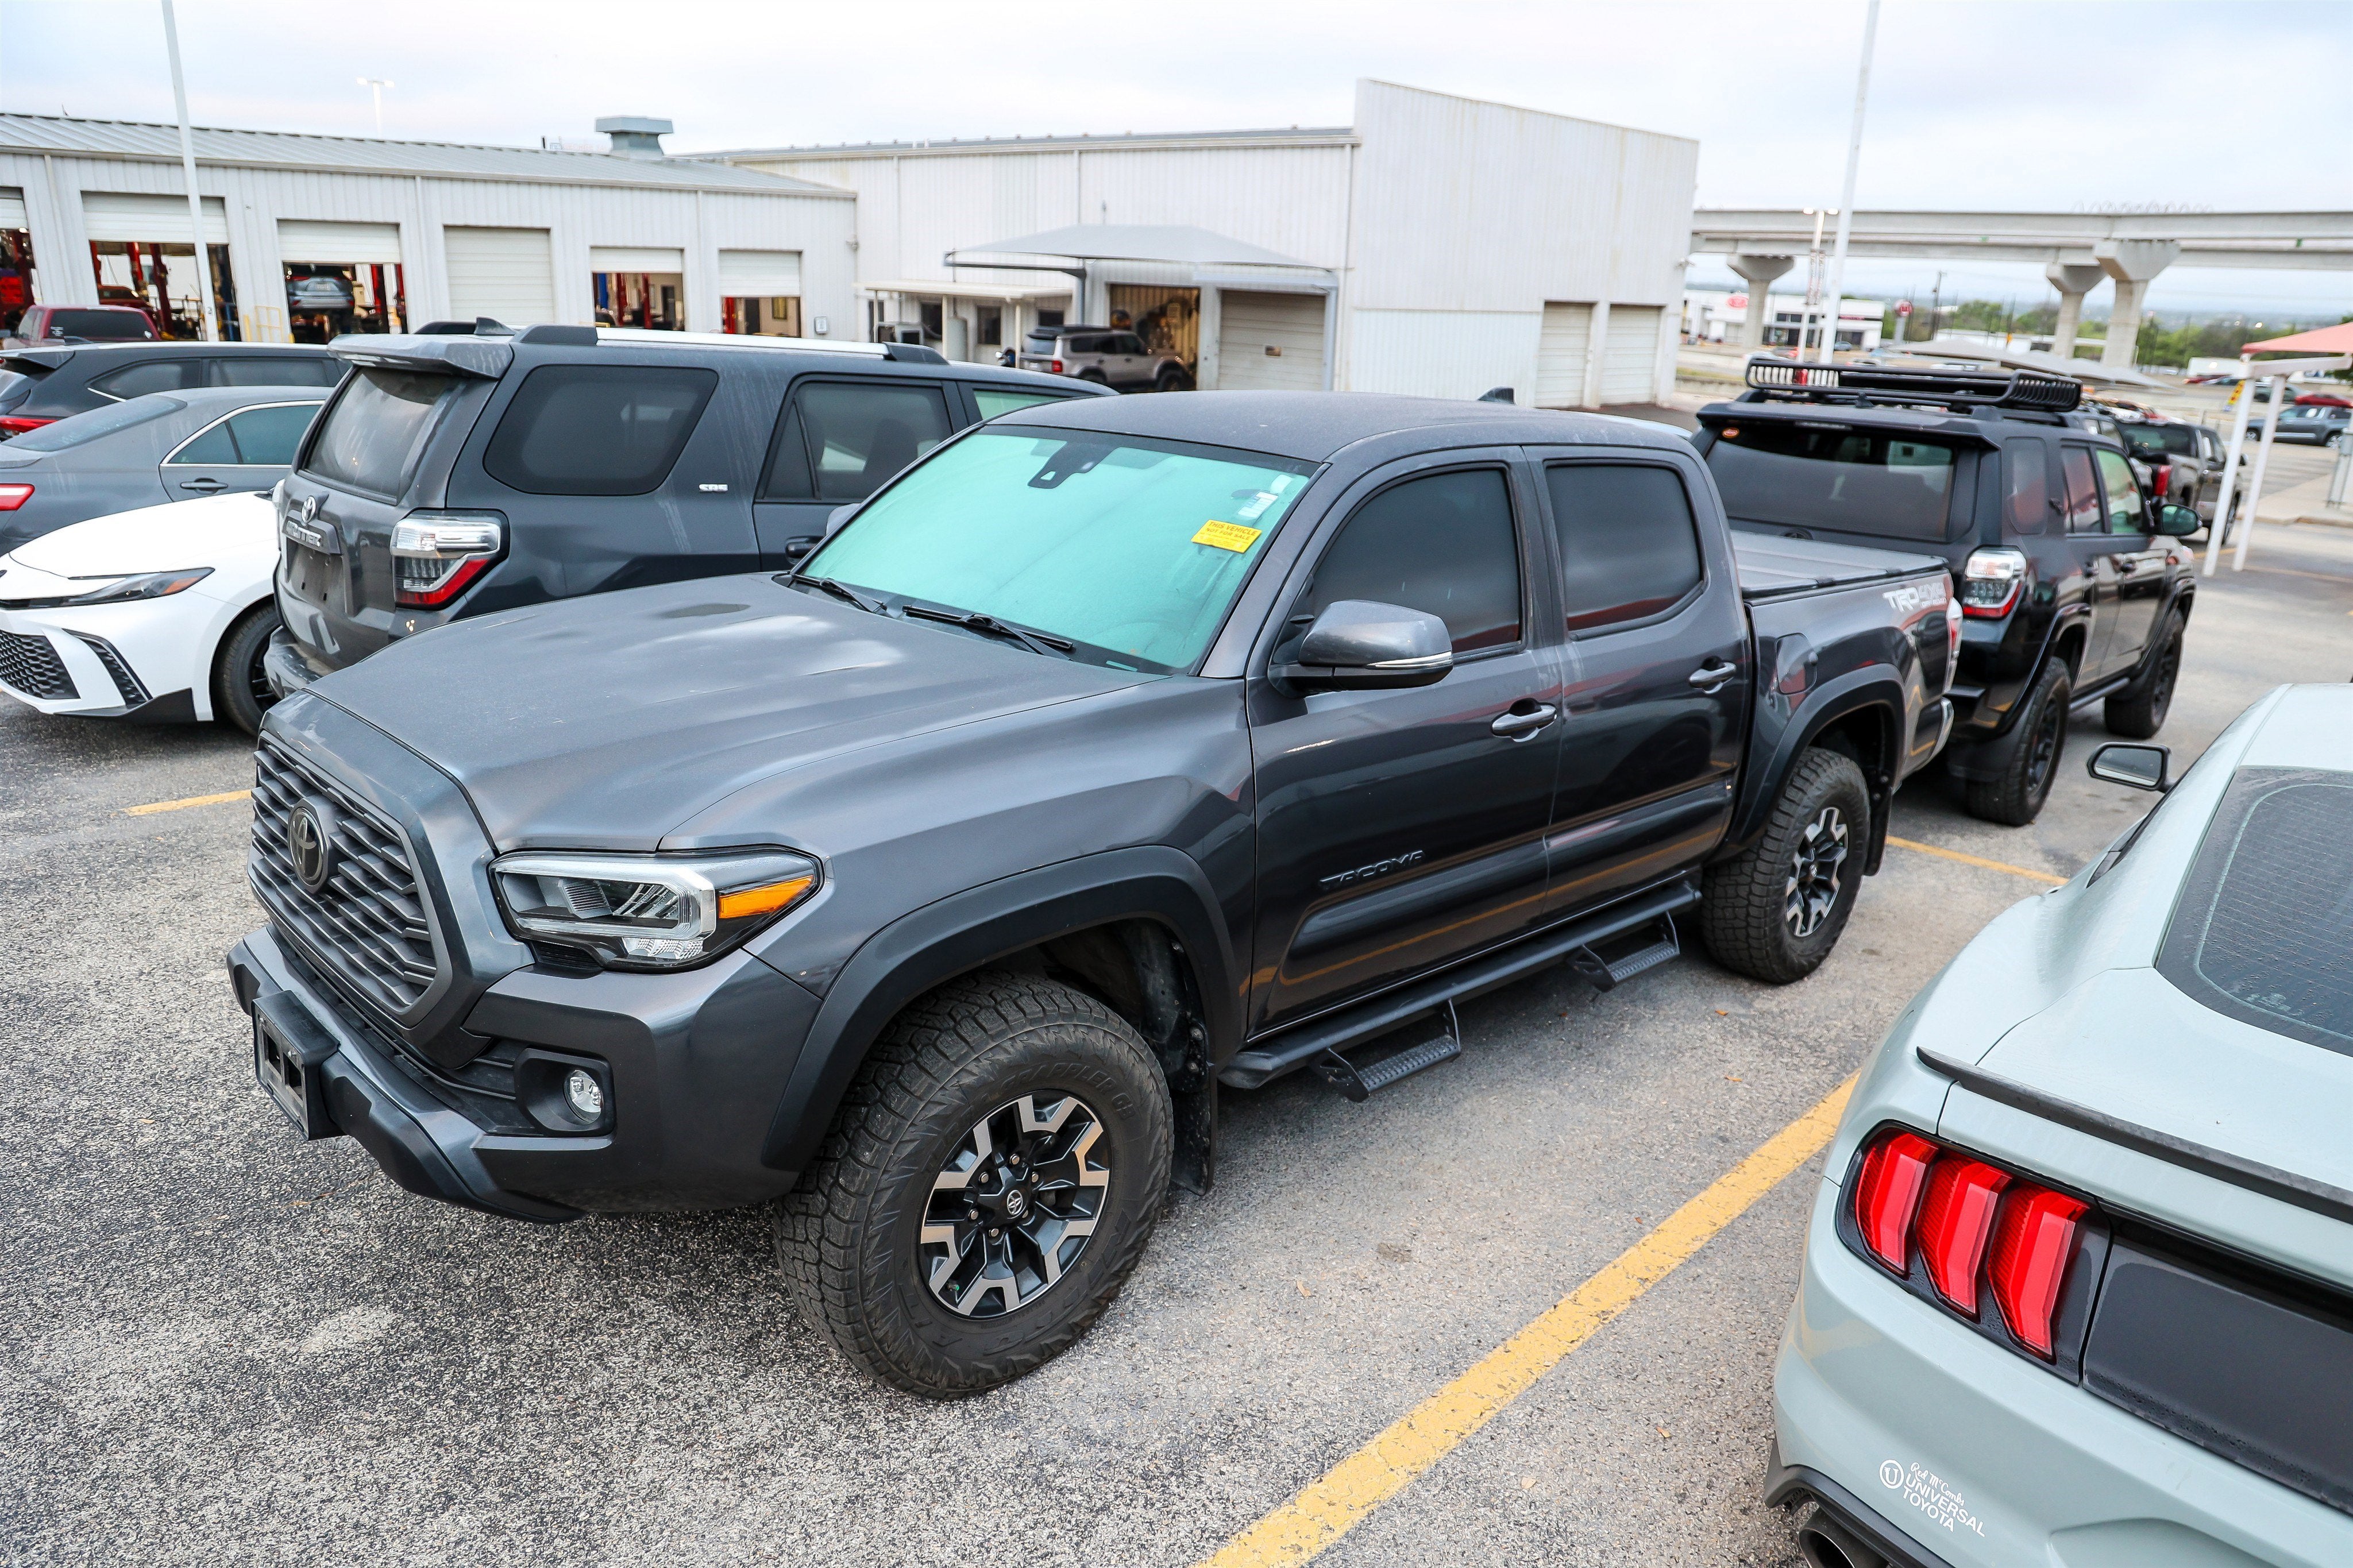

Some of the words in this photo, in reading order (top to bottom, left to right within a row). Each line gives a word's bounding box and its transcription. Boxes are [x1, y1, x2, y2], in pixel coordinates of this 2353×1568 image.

[1208, 521, 1225, 529] THIS
[1226, 525, 1258, 536] VEHICLE
[1882, 586, 1920, 613] TRD
[1318, 850, 1425, 889] TACOMA
[1910, 1462, 1928, 1482] Red
[1929, 1472, 1965, 1506] McCombs
[1903, 1485, 1954, 1532] TOYOTA
[1905, 1473, 1985, 1538] UNIVERSAL
